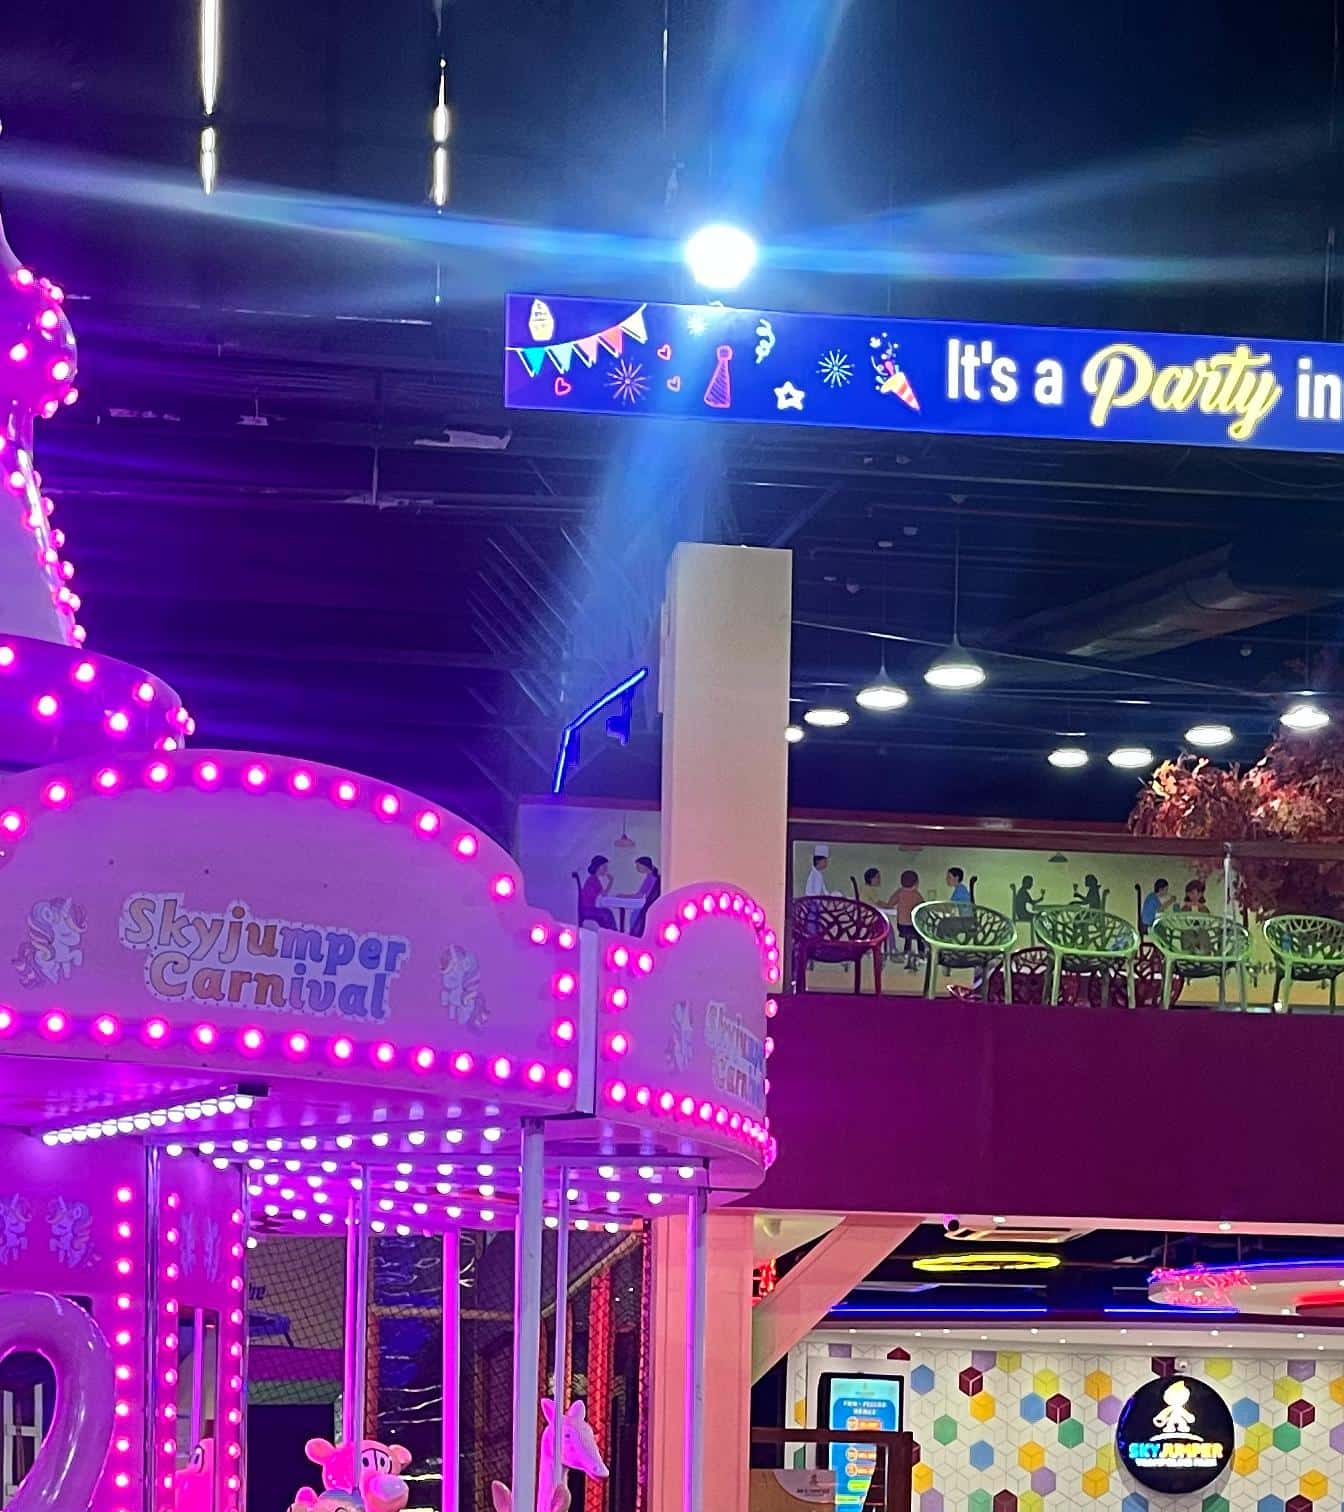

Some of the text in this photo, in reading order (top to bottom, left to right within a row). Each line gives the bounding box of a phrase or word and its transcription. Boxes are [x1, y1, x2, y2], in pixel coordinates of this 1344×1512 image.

[946, 338, 1018, 402] It's
[1034, 358, 1064, 405] a
[1081, 343, 1283, 441] Party
[1296, 357, 1344, 420] in
[124, 897, 407, 976] Skyjumper
[148, 951, 387, 1020] Carnival
